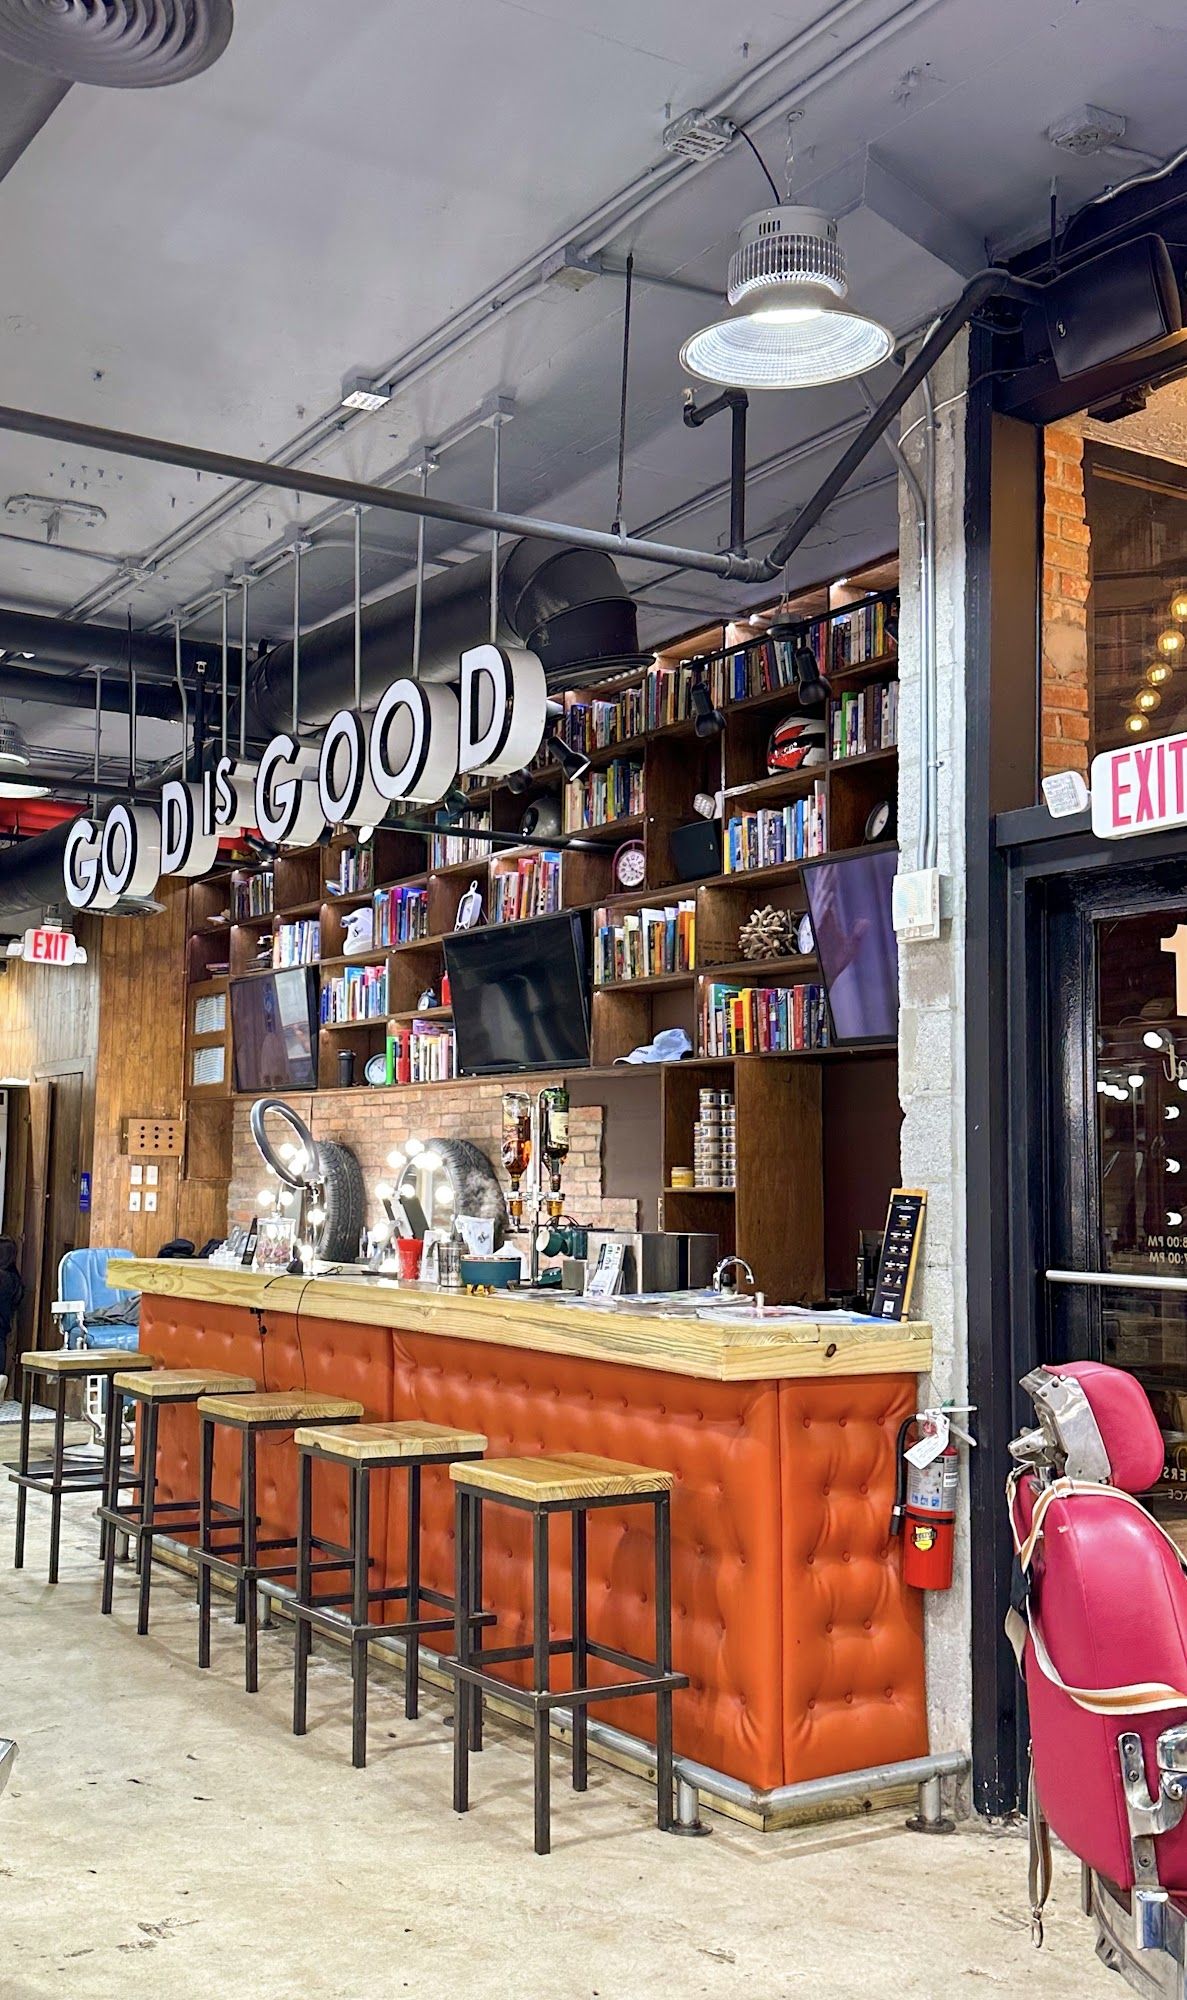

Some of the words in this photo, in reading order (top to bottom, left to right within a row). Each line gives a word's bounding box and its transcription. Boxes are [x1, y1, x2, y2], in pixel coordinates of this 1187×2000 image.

[202, 756, 236, 836] IS
[255, 643, 515, 843] GOOD
[1111, 738, 1187, 828] EXIT
[32, 931, 70, 962] EXIT
